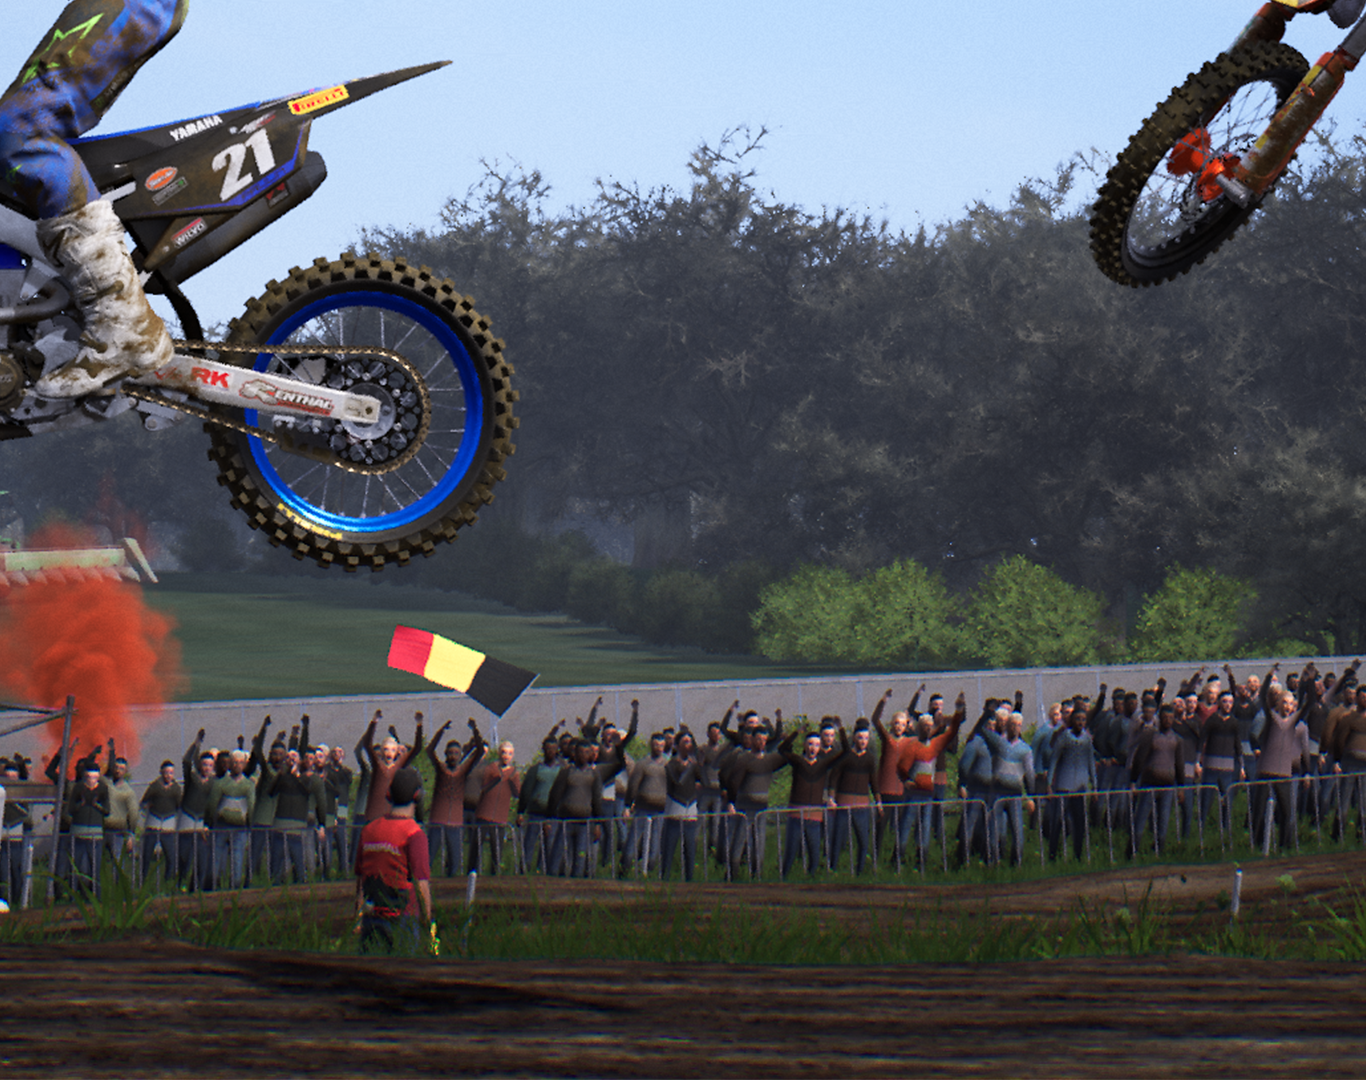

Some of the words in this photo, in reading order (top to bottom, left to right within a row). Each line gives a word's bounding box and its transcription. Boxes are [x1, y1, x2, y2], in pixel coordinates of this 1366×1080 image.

[169, 114, 223, 142] YAMAHA
[212, 128, 276, 202] 21
[174, 222, 207, 248] WILVO
[191, 366, 231, 389] RK
